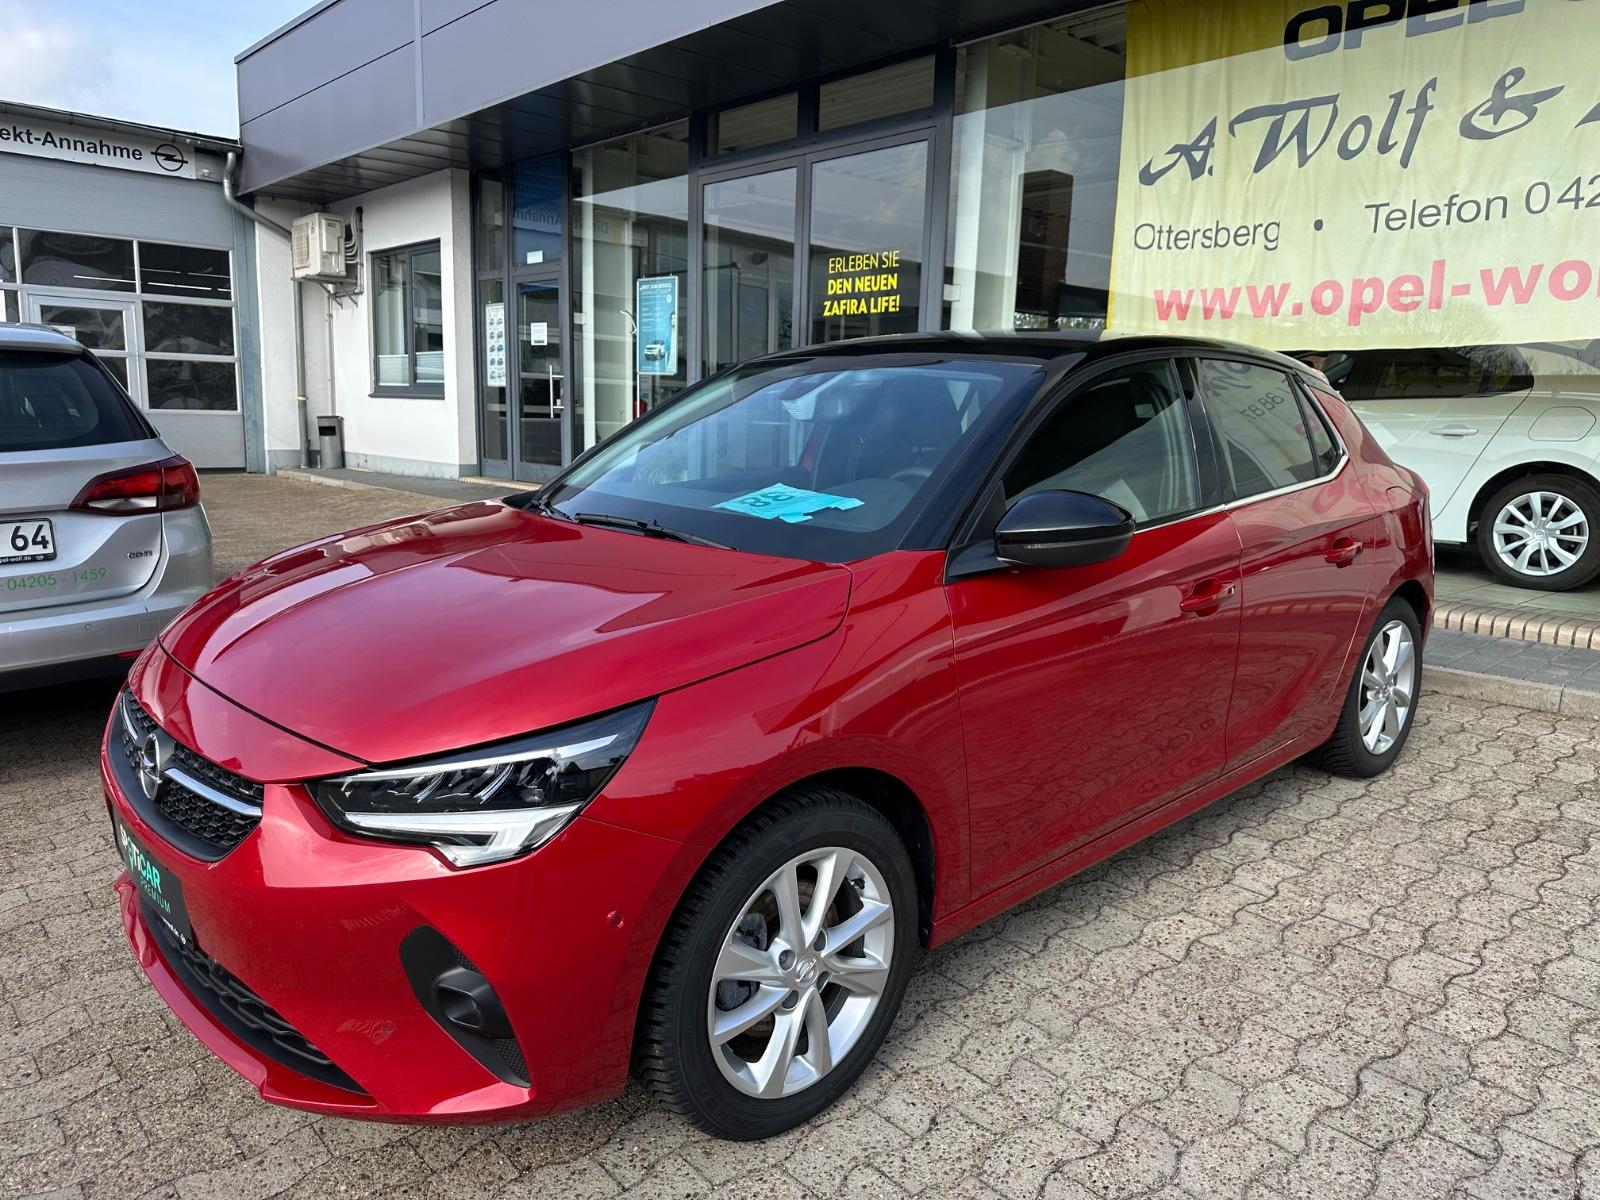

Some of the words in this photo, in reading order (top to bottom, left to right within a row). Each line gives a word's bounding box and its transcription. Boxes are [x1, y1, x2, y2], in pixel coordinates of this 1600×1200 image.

[1228, 76, 1438, 174] Wolf
[1459, 66, 1566, 140] &
[1133, 219, 1281, 251] Ottersberg
[1364, 193, 1509, 234] Telefon
[828, 253, 879, 274] ERLEBEN
[881, 250, 900, 268] SIE
[827, 278, 852, 295] DEN
[854, 273, 898, 293] NEUEN
[1153, 258, 1600, 327] www.opel-wo
[823, 298, 868, 317] ZAFIRA
[870, 294, 900, 313] LIFE!
[10, 524, 50, 551] 64
[7, 575, 57, 592] 04205
[72, 567, 108, 584] 1459
[141, 876, 172, 914] PREMIUM
